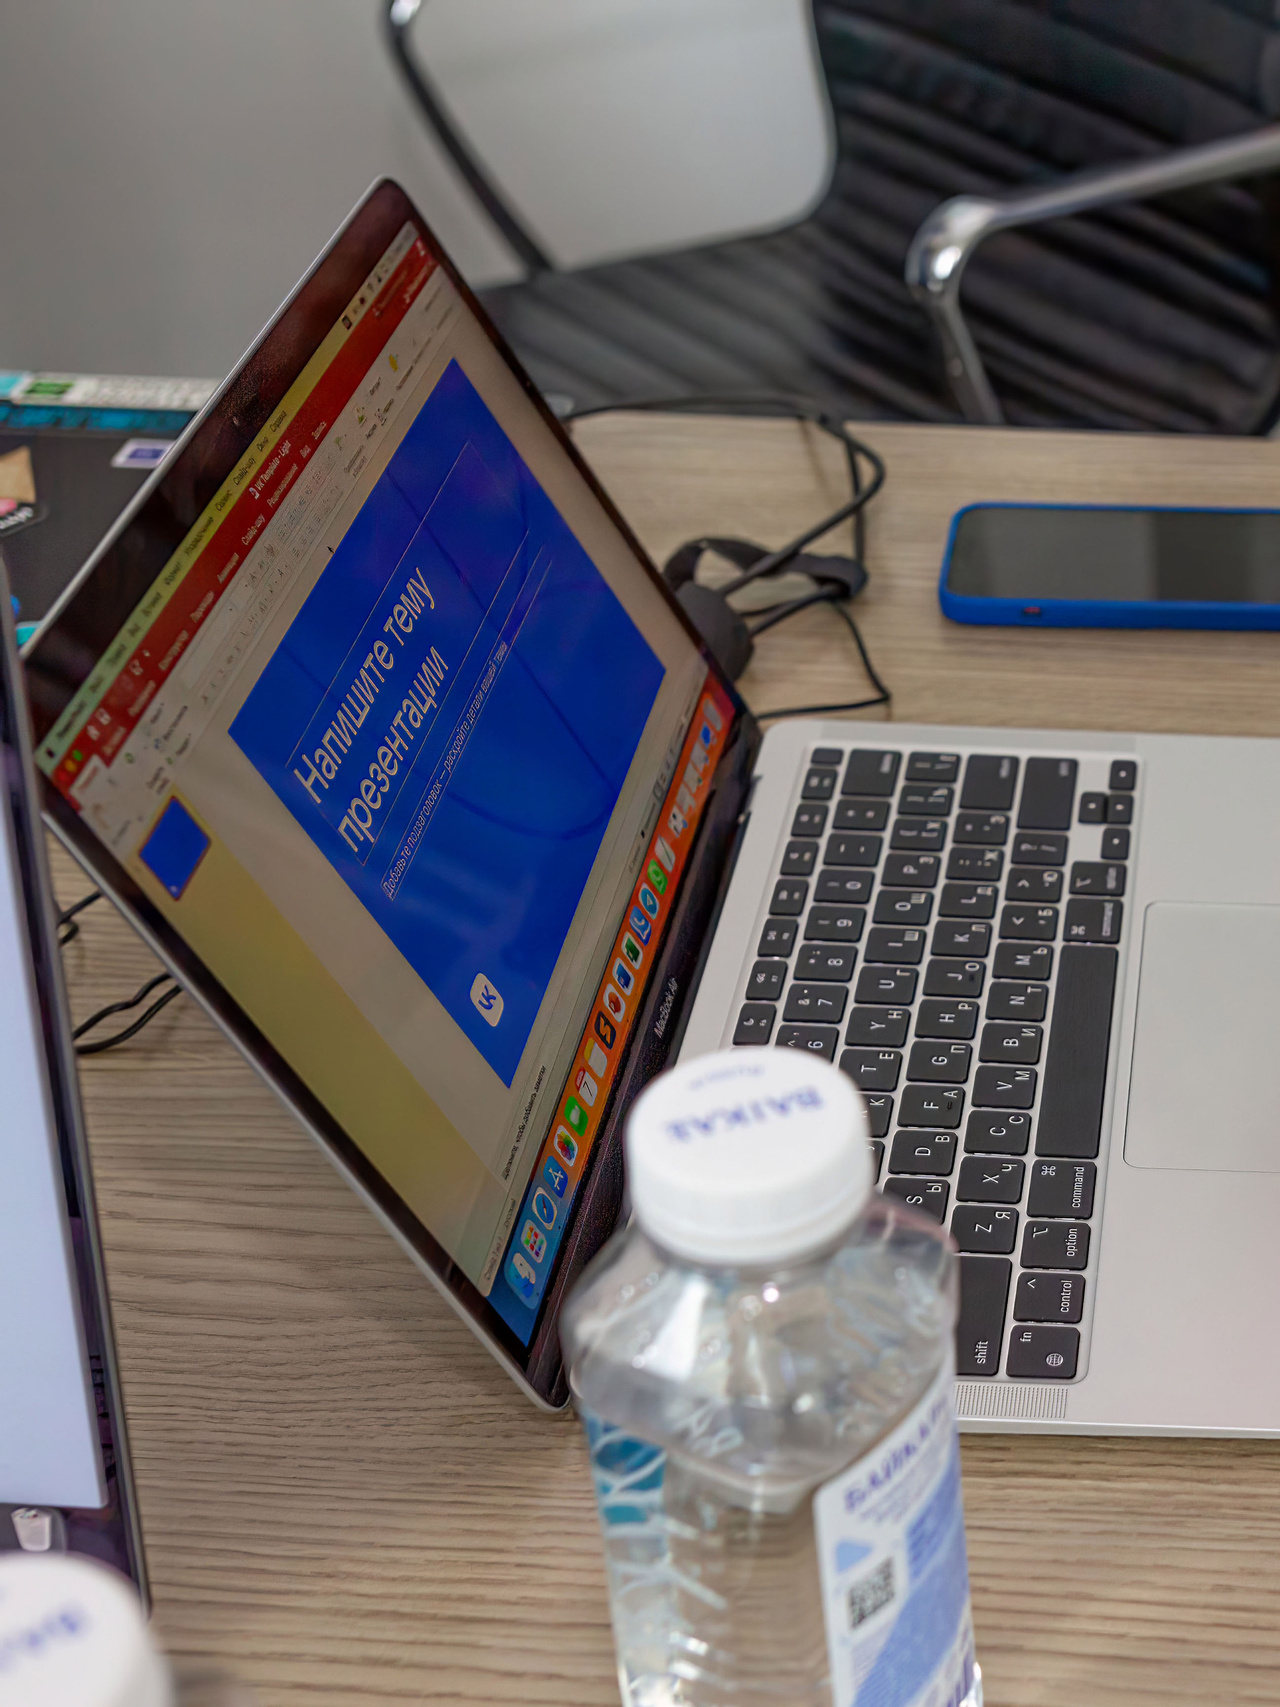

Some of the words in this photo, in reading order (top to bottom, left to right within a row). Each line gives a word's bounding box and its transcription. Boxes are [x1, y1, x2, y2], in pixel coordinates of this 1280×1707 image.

[255, 479, 264, 490] VK
[261, 458, 279, 482] Template
[279, 440, 291, 456] Light
[294, 639, 394, 805] Напишите
[383, 567, 435, 647] тему
[337, 645, 449, 852] презентации
[382, 847, 411, 899] Добавьте
[407, 781, 442, 847] подзаголовок
[444, 720, 470, 773] раскройте
[466, 690, 484, 724] детали
[947, 973, 963, 981] J
[878, 979, 895, 989] U
[818, 998, 833, 1006] 7
[1009, 995, 1026, 1005] N
[654, 991, 674, 1038] MacBook
[668, 977, 678, 995] Air
[939, 1013, 955, 1023] H
[870, 1021, 886, 1030] Y
[808, 1040, 824, 1049] 6
[1003, 1038, 1019, 1046] B
[951, 1045, 966, 1053] П
[931, 1056, 948, 1065] G
[861, 1064, 877, 1073] T
[582, 1080, 593, 1096] 7
[996, 1081, 1013, 1090] V
[923, 1101, 939, 1109] F
[915, 1147, 931, 1156] D
[982, 1174, 999, 1183] X
[926, 1183, 942, 1192] Ы
[1072, 1166, 1084, 1208] command
[906, 1195, 922, 1204] S
[995, 1211, 1010, 1219] Я
[975, 1224, 992, 1232] Z
[1066, 1228, 1078, 1256] option
[1060, 1280, 1072, 1312] control
[1020, 1332, 1032, 1342] fn
[975, 1340, 988, 1364] shift
